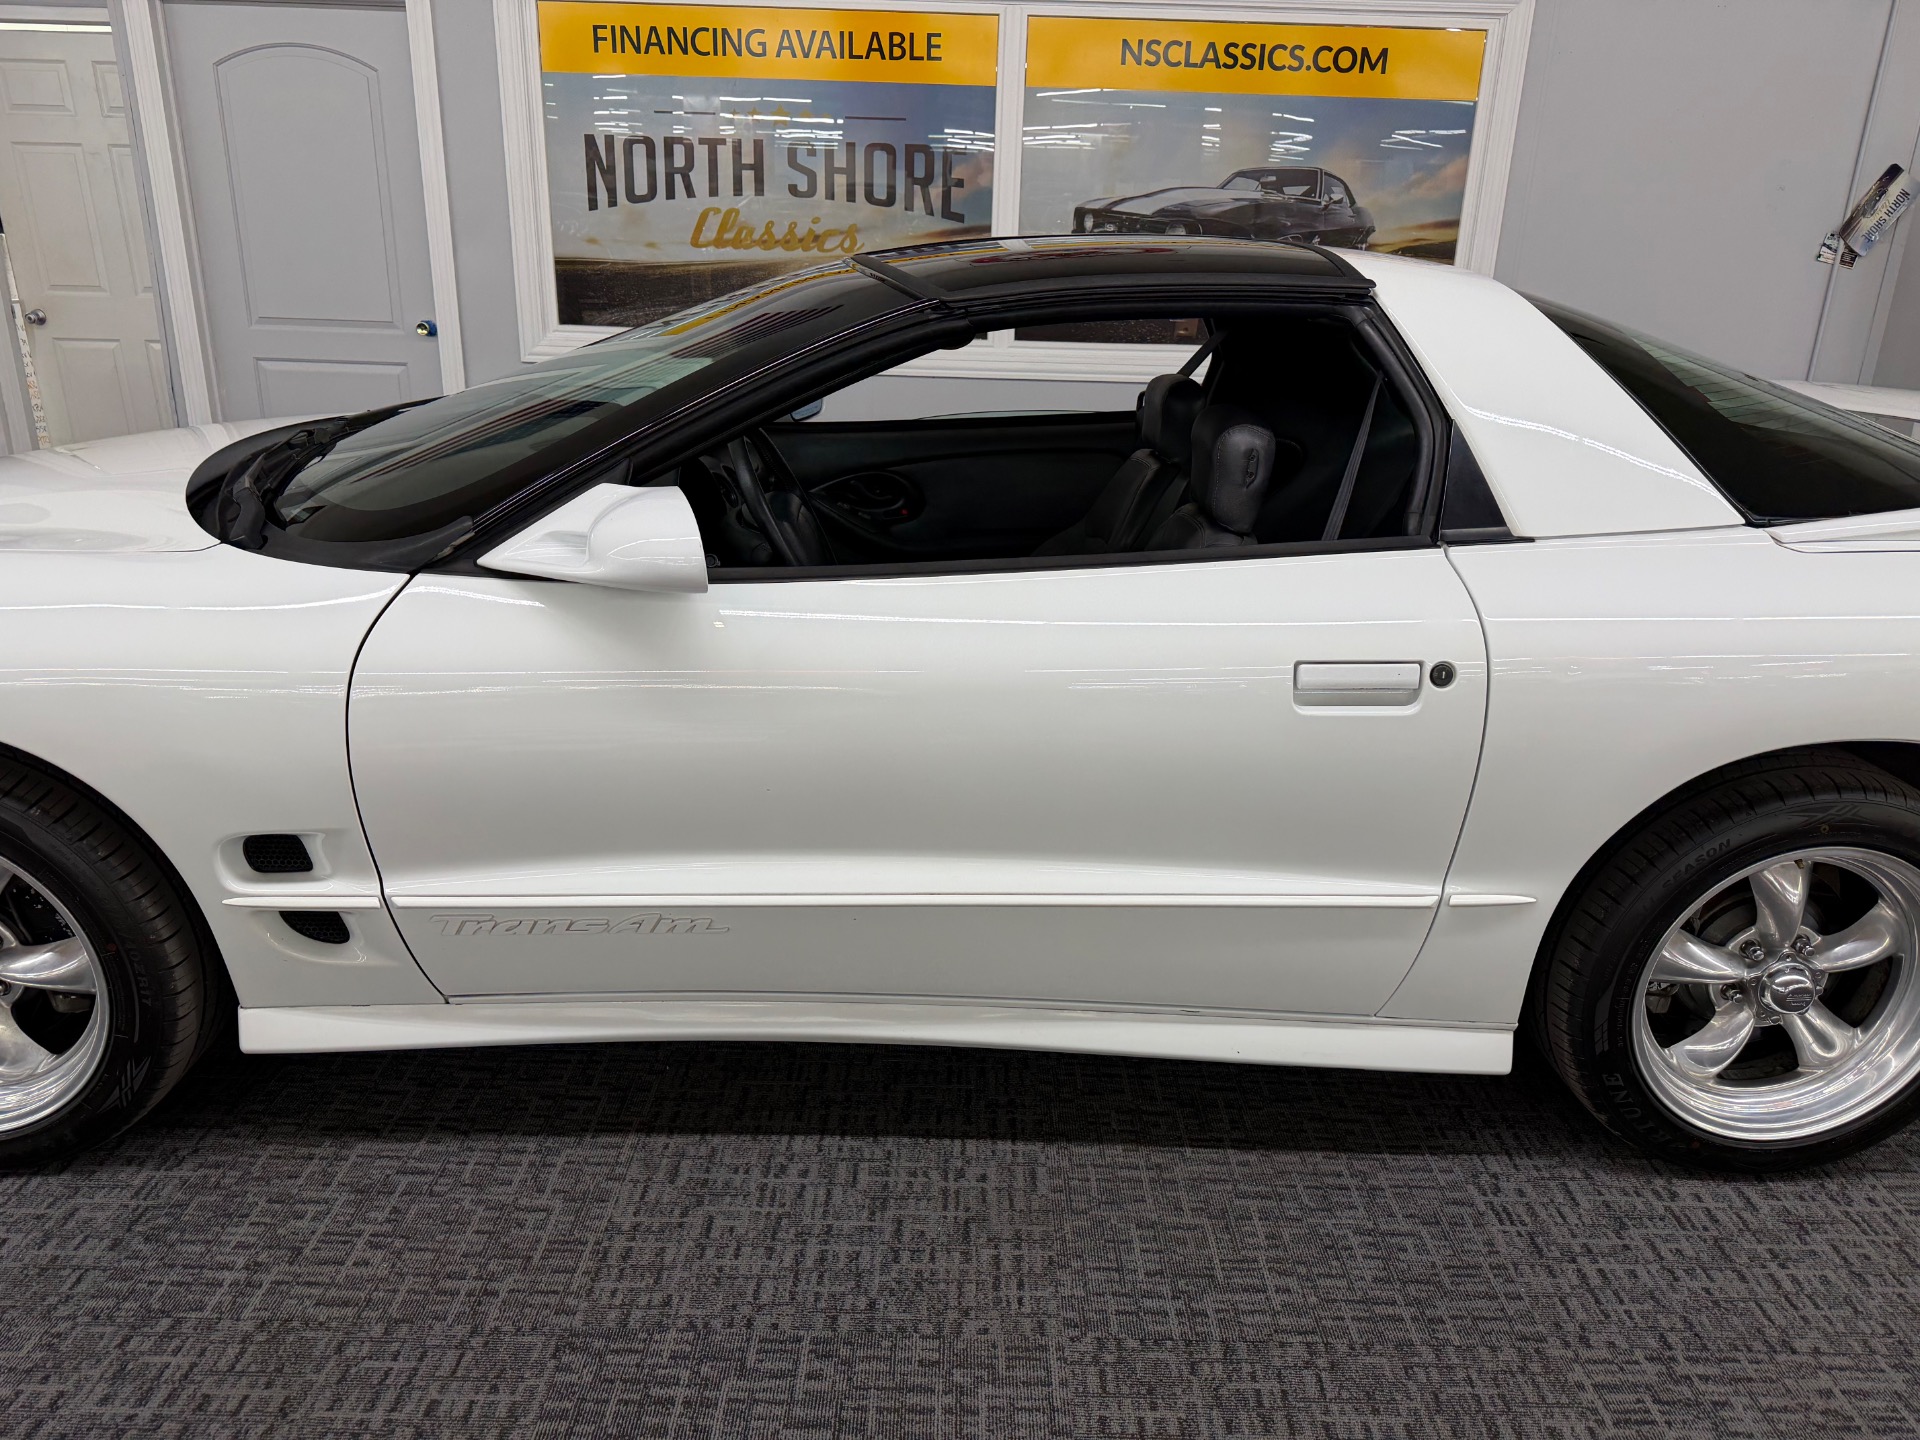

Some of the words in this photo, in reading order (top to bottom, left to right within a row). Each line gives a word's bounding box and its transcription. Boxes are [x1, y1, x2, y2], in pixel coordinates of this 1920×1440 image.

[592, 24, 767, 58] FINANCING
[775, 29, 943, 62] AVAILABLE
[1120, 38, 1390, 75] NSCLASSICS.COM
[583, 133, 765, 211] NORTH
[787, 139, 967, 224] SHORE
[1884, 187, 1911, 218] NORTH
[690, 206, 864, 254] Classics
[1662, 838, 1731, 889] SEASON
